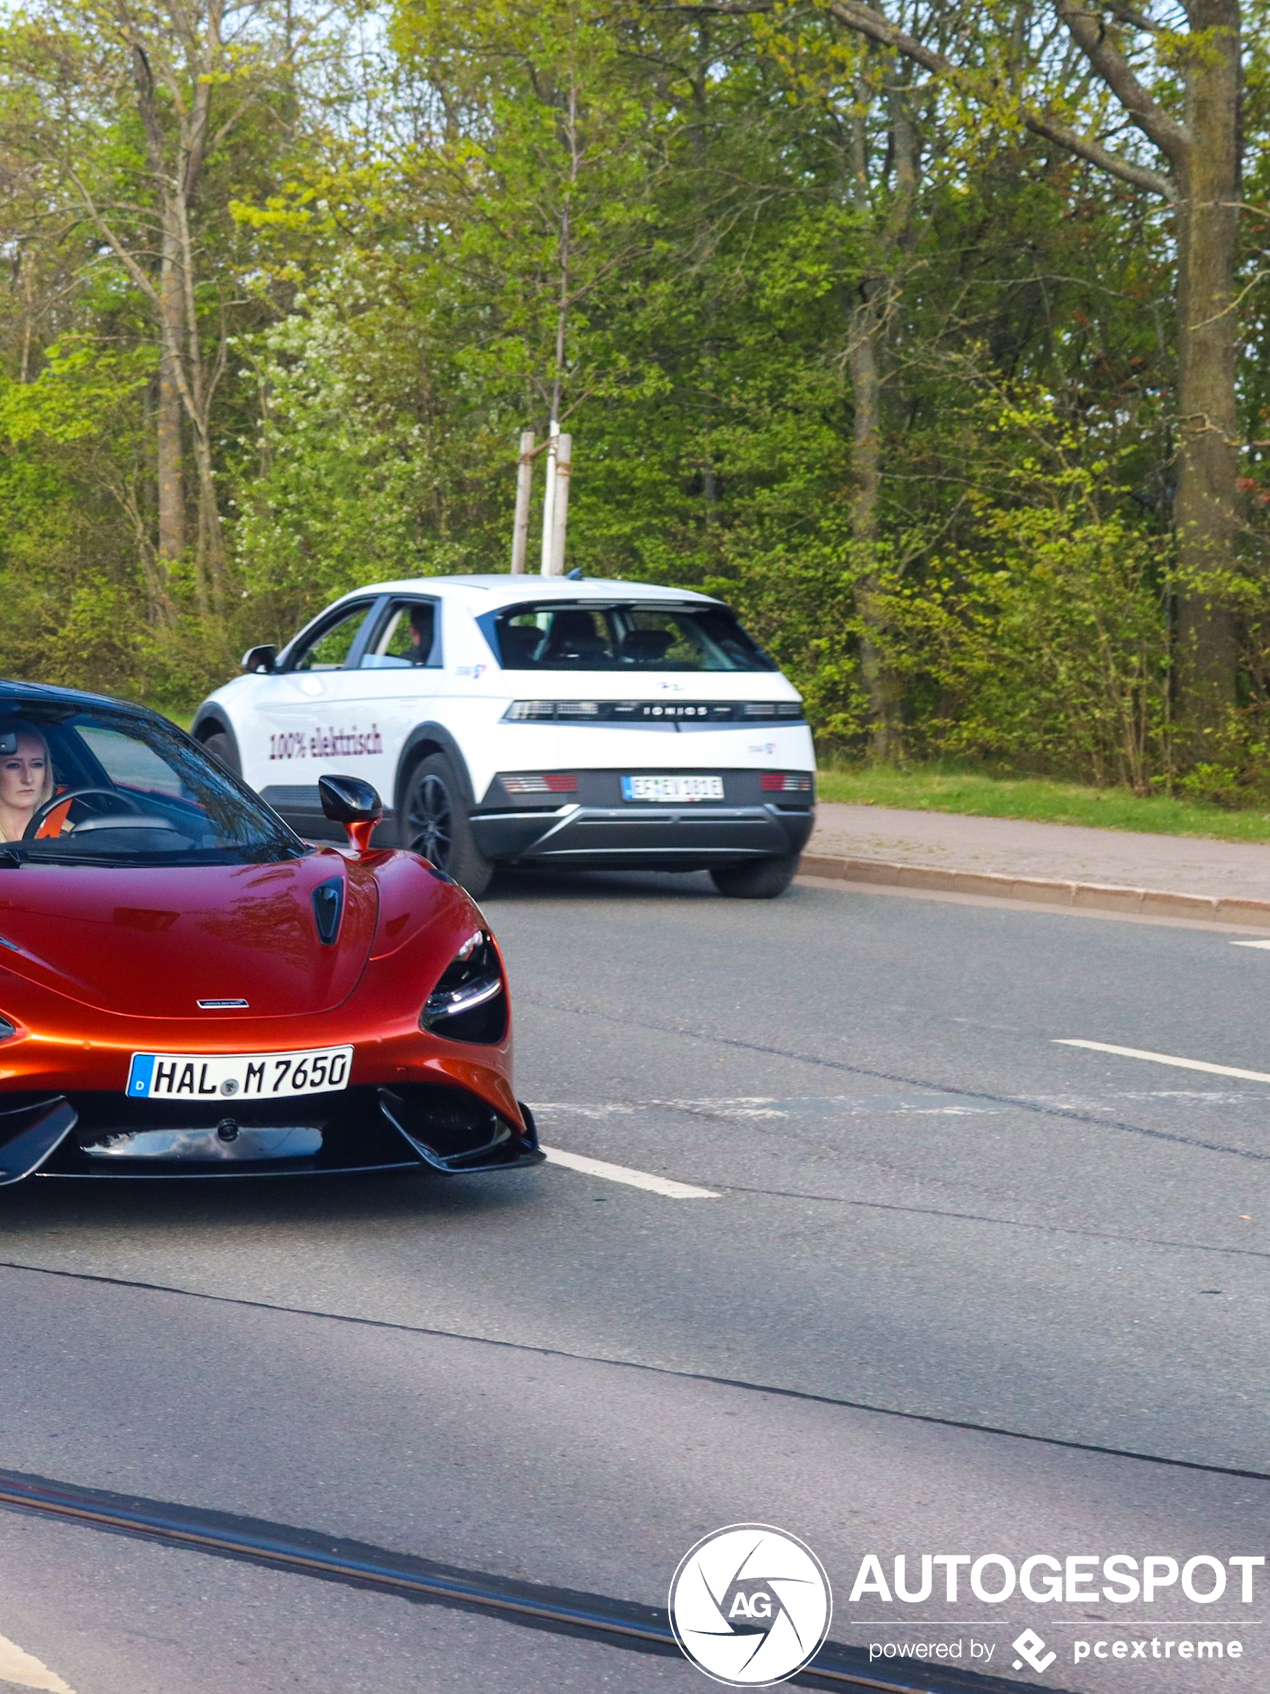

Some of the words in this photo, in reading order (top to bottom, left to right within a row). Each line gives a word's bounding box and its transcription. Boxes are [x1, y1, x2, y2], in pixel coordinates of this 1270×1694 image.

[270, 732, 306, 760] 100%
[310, 723, 383, 757] elektrisch
[153, 1061, 217, 1094] HAL
[243, 1061, 266, 1094] M
[272, 1054, 347, 1092] 7650
